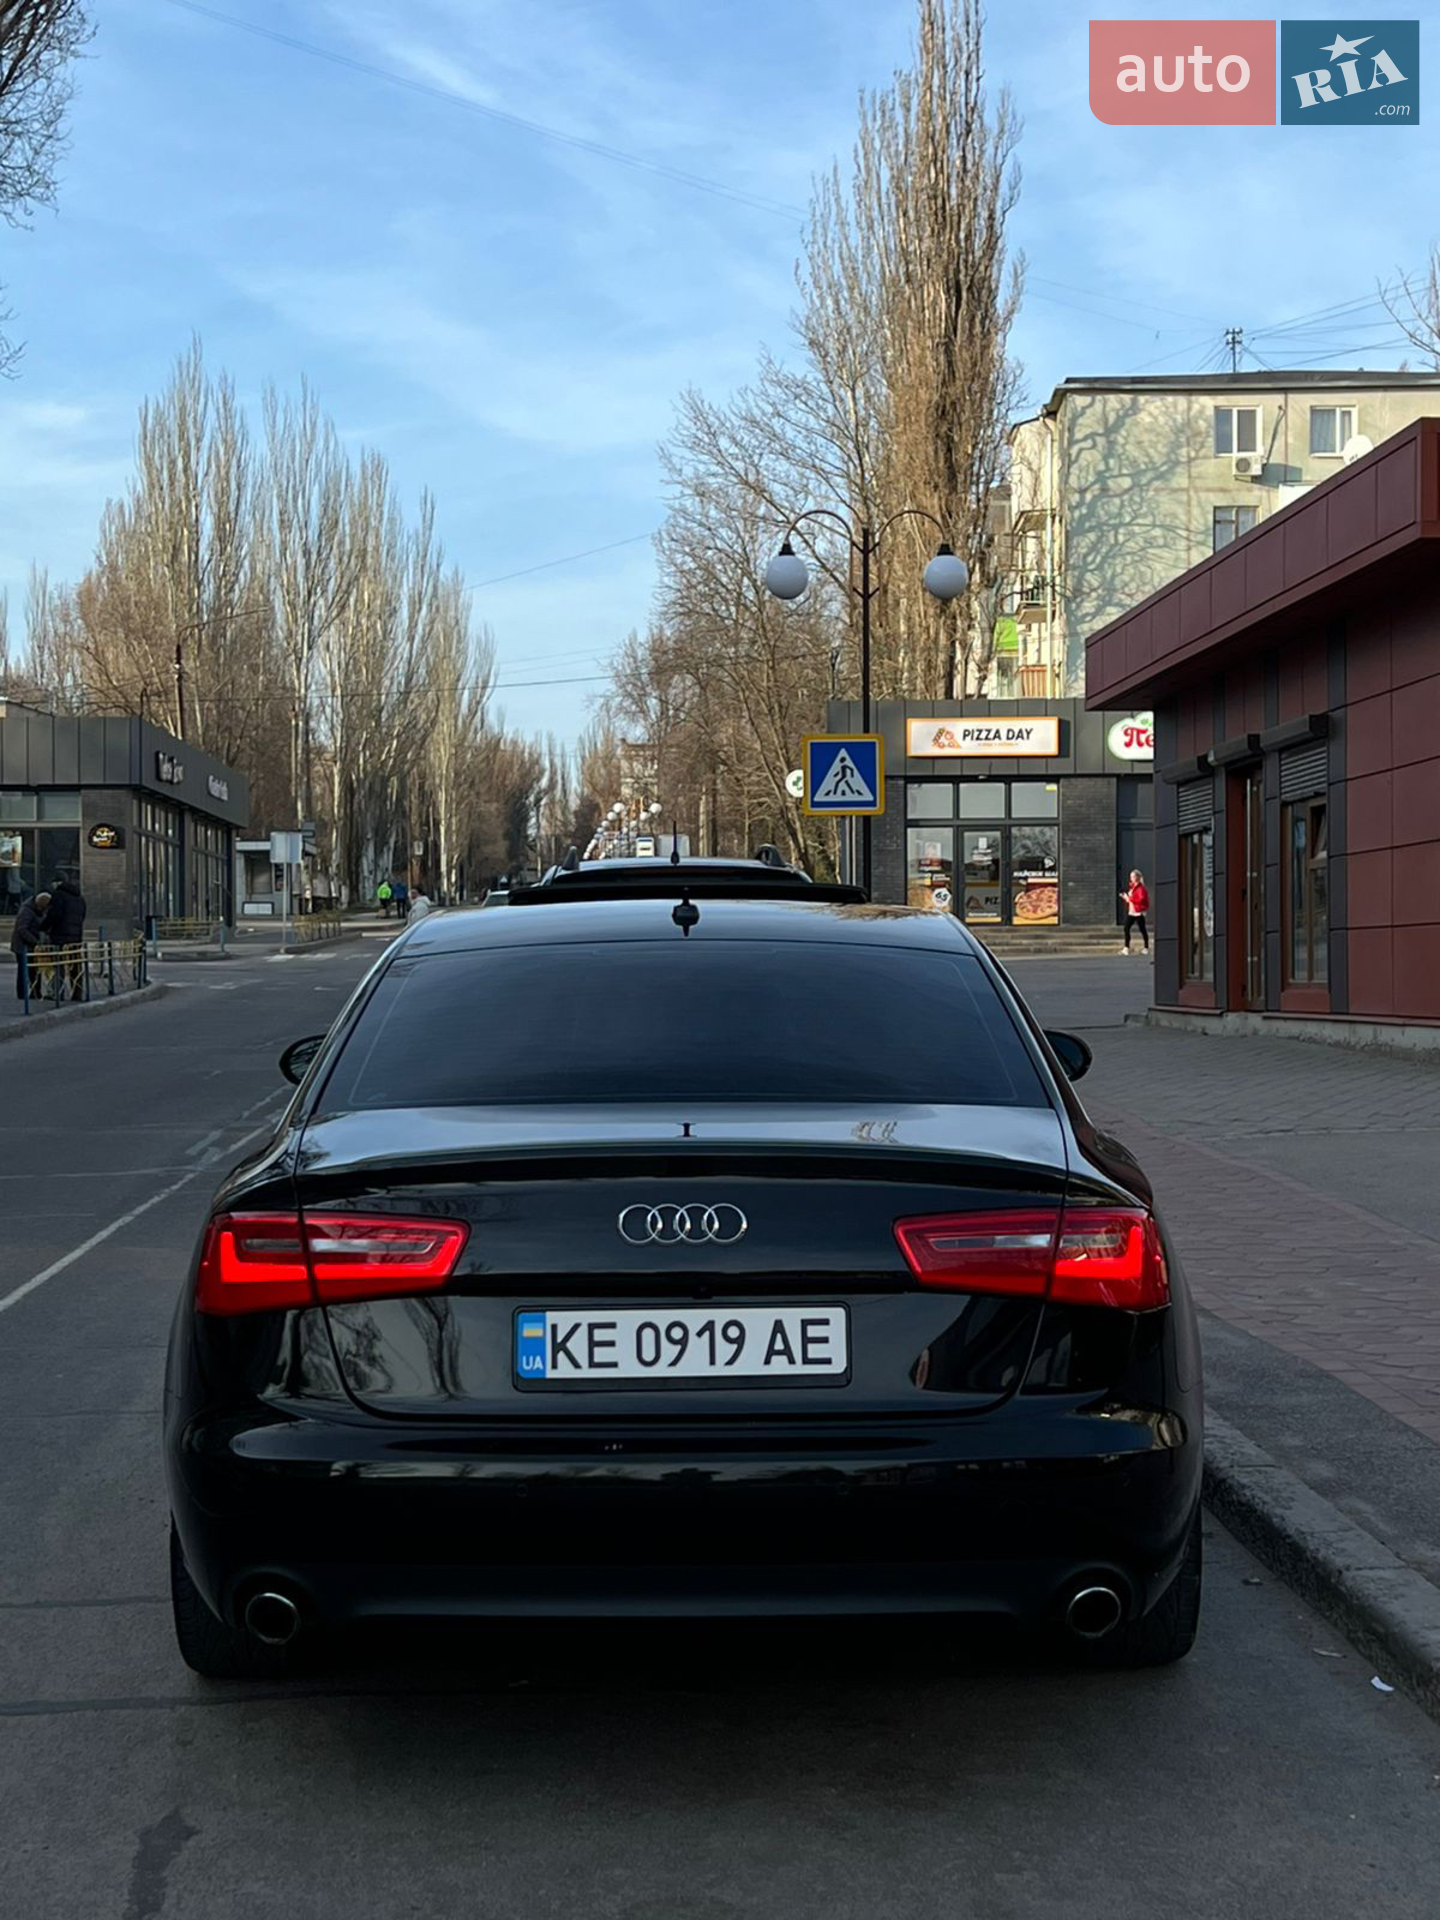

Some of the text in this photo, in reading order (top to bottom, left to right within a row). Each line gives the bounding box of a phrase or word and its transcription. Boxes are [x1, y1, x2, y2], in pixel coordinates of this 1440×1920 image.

[962, 728, 1034, 741] PIZZA DAY
[550, 1318, 833, 1370] KE 0919 AE
[522, 1355, 544, 1371] UA
